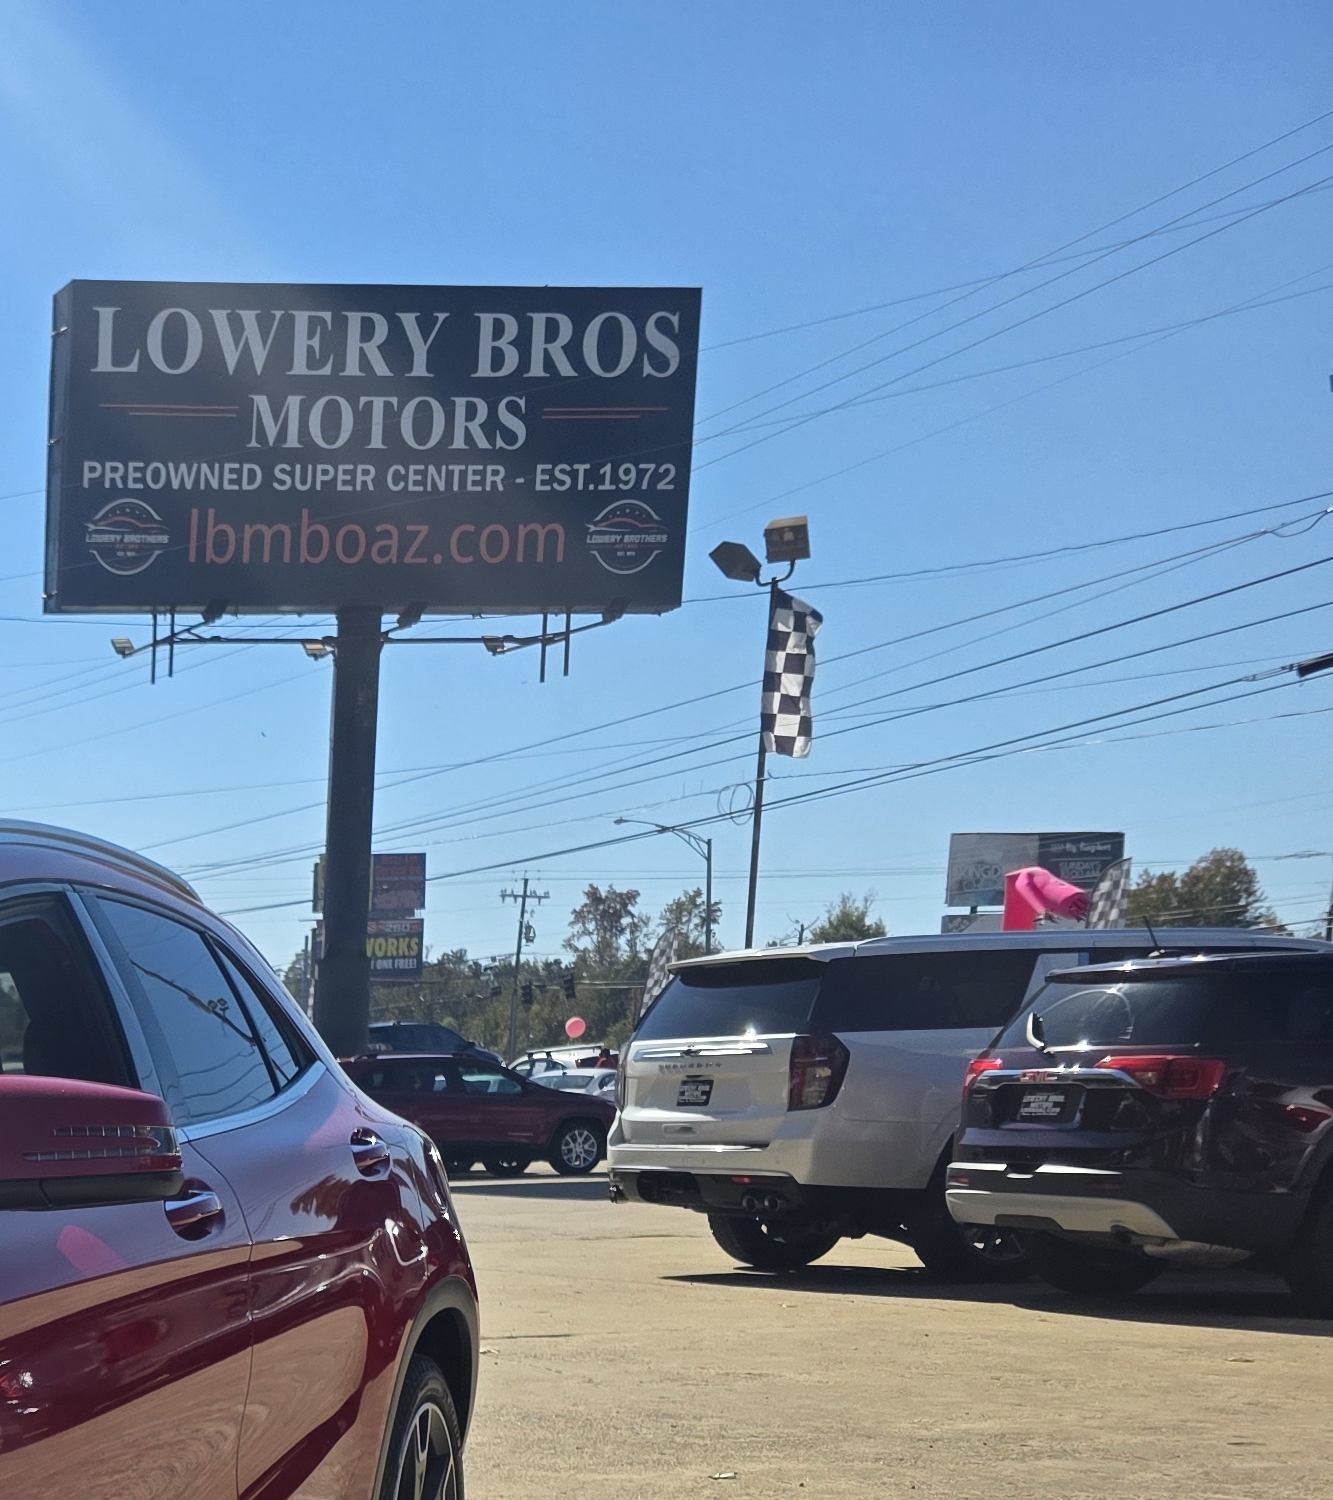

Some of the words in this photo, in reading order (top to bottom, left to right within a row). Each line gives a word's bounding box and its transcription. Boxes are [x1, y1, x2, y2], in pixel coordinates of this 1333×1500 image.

[90, 306, 450, 378] LOWERY
[470, 311, 681, 379] BROS
[245, 394, 527, 451] MOTORS
[82, 460, 263, 491] PREOWNED
[272, 463, 376, 492] SUPER
[386, 463, 506, 492] CENTER
[535, 462, 676, 492] EST.1972
[188, 507, 566, 565] lbmboaz.com
